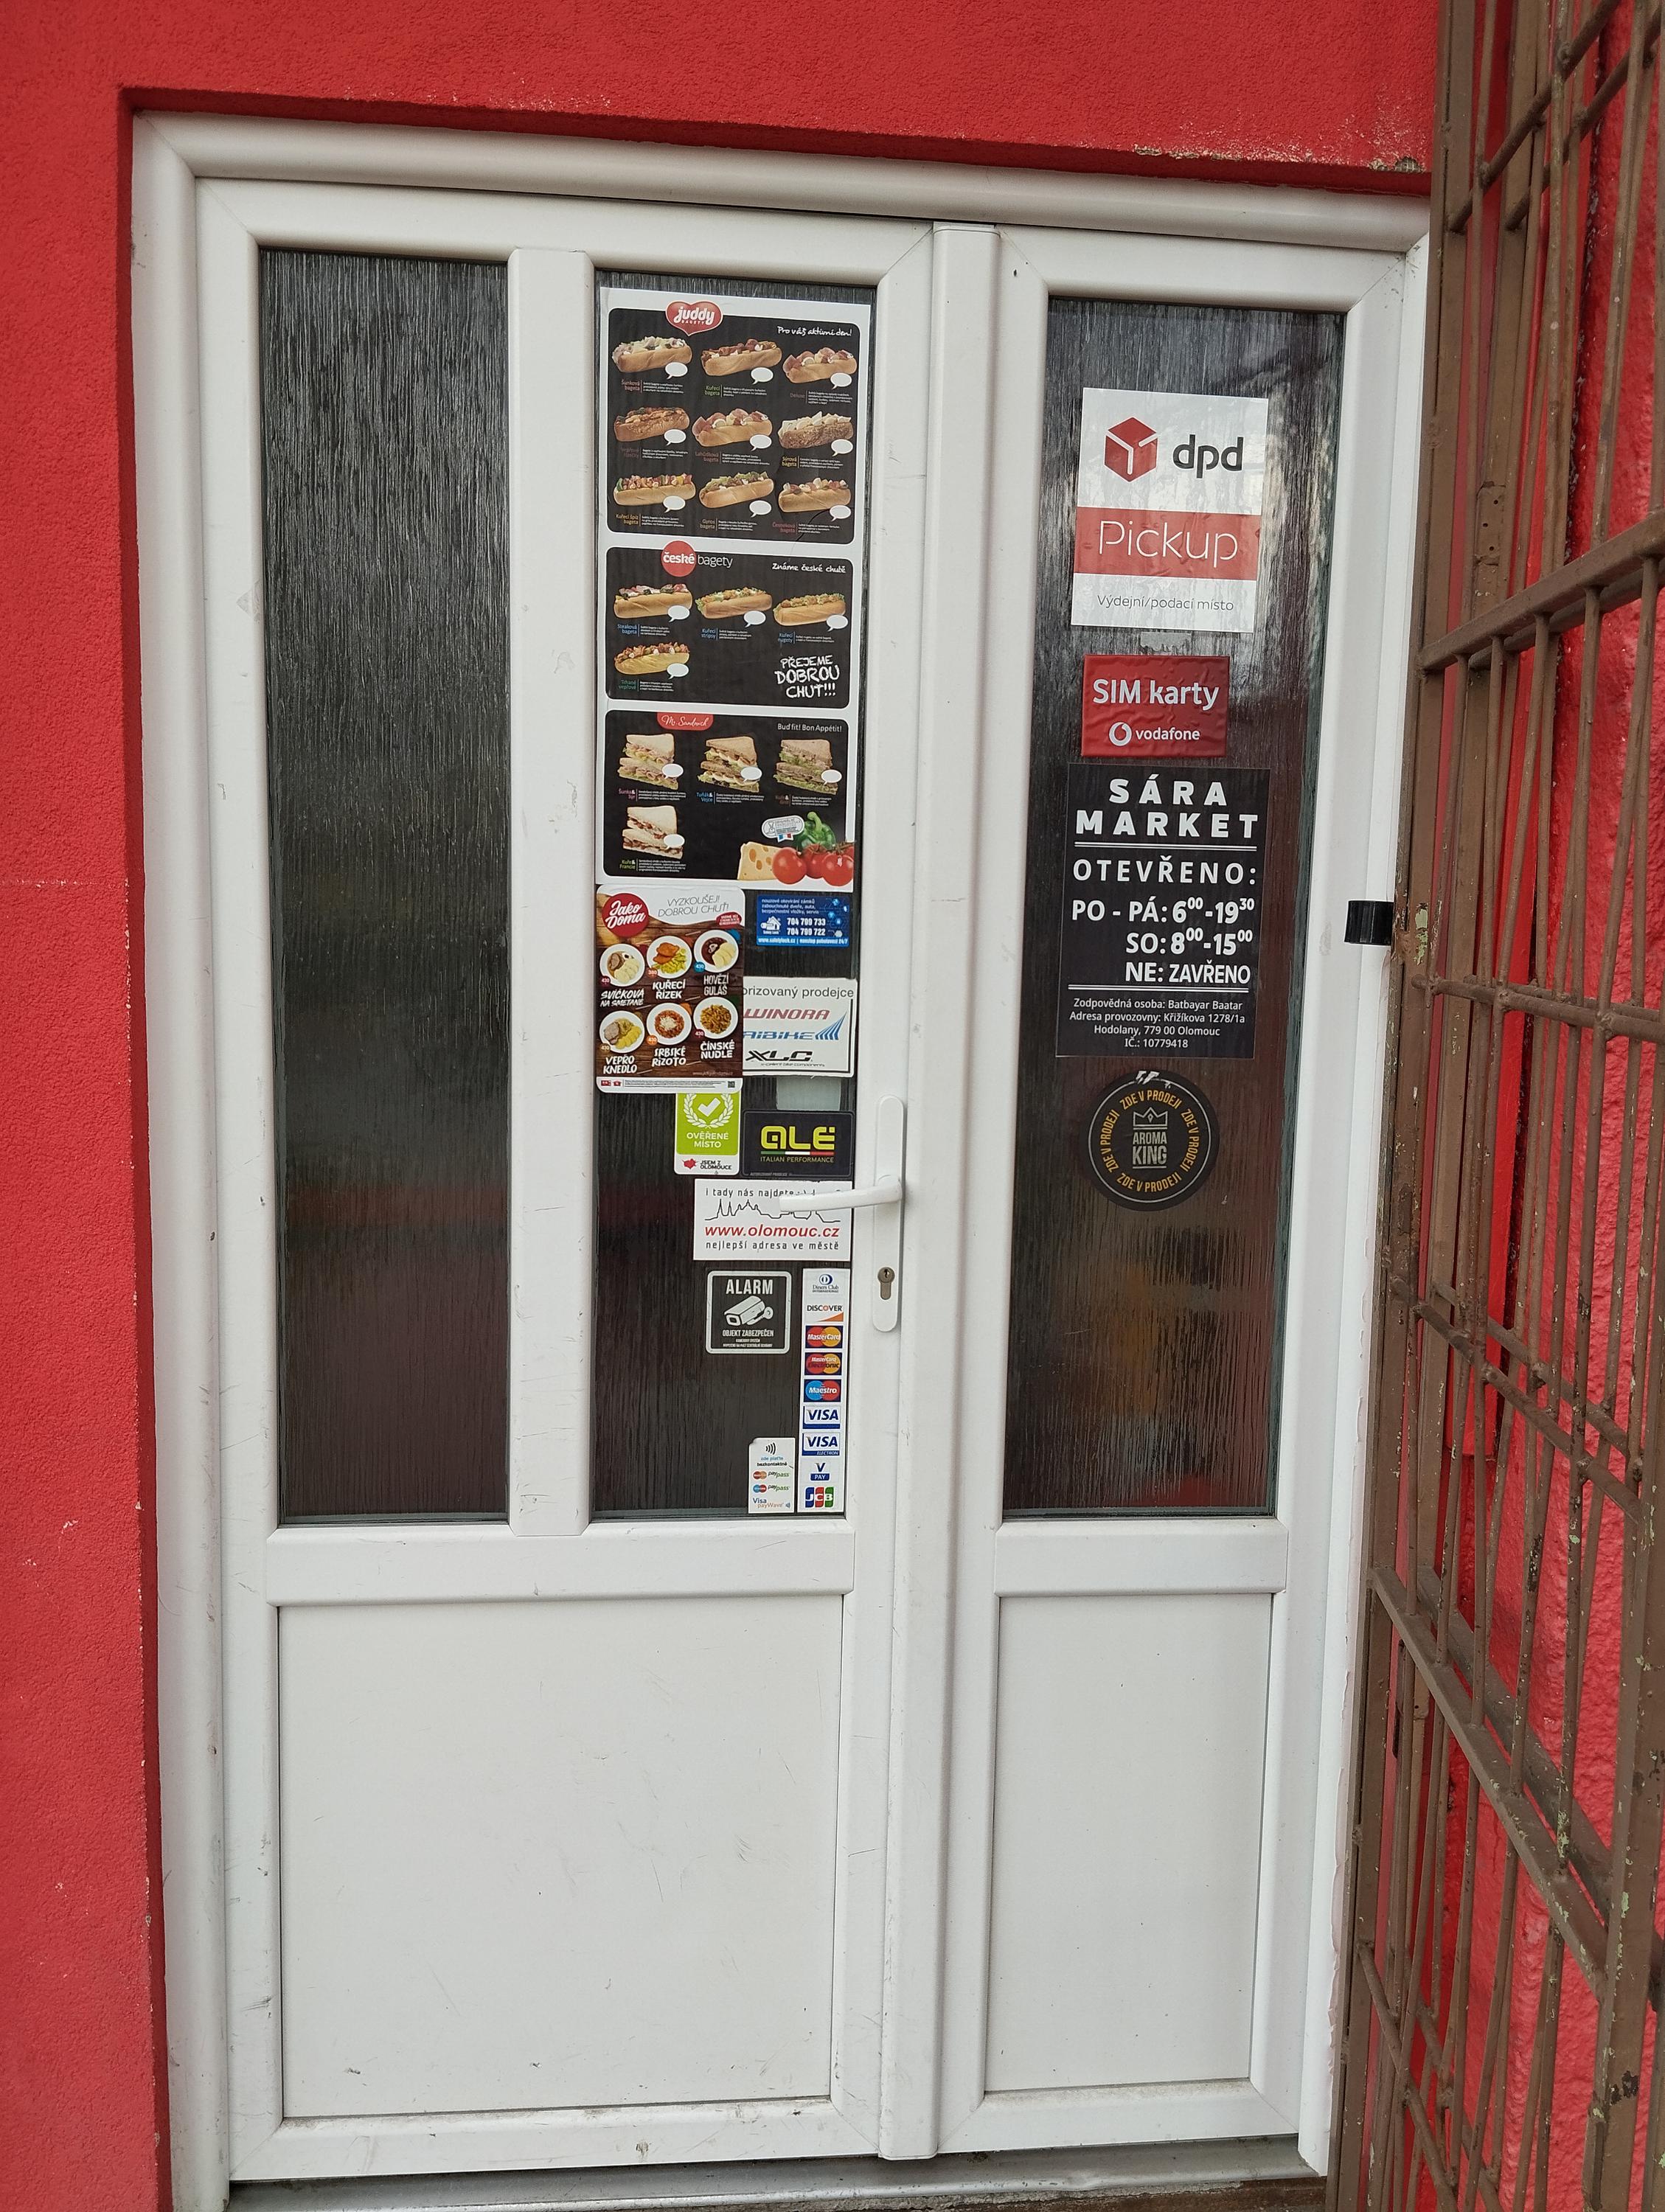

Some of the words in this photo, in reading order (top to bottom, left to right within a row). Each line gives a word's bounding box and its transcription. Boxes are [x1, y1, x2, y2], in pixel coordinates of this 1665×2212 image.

[674, 307, 715, 325] juddy
[777, 326, 790, 335] Pro
[1172, 434, 1244, 479] dpd
[1098, 520, 1238, 568] Pickup
[663, 552, 695, 564] české
[698, 555, 733, 568] bagety
[772, 563, 799, 571] Známe
[802, 564, 823, 572] české
[826, 565, 847, 573] chutě
[1097, 594, 1193, 611] Výdejní/podací
[1198, 599, 1234, 611] místo
[780, 655, 833, 669] PŘEJEME
[774, 664, 840, 684] DOBROU
[1093, 679, 1141, 704] SIM
[1149, 680, 1220, 712] karty
[1136, 727, 1200, 740] vodafone
[1109, 773, 1227, 806] SÁRA
[1076, 810, 1258, 838] MARKET
[1073, 855, 1256, 885] OTEVŘENO:
[667, 894, 720, 906] VYZKOUŠEJ!
[610, 900, 642, 916] Jako
[658, 906, 698, 917] DOBROU
[1072, 900, 1105, 921] PO
[605, 912, 646, 928] Doma
[787, 917, 799, 926] 704
[813, 918, 826, 926] 733
[787, 928, 799, 936] 704
[1125, 961, 1164, 982] NE:
[1169, 959, 1251, 984] ZAVŘENO
[653, 979, 686, 990] KUŘECÍ
[703, 973, 729, 985] HOVĚZÍ
[656, 989, 682, 1000] ŘÍZEK
[704, 984, 728, 995] GULÁŠ
[743, 986, 798, 998] orizovaný
[802, 987, 854, 999] prodejce
[1074, 998, 1131, 1009] Zodpovědná
[1134, 1000, 1165, 1009] osoba:
[1168, 1001, 1209, 1012] Batbayar
[1212, 1001, 1242, 1010] Baatar
[743, 1009, 830, 1020] WINORA
[1069, 1012, 1102, 1020] Adresa
[1105, 1014, 1161, 1023] provozovny:
[1164, 1013, 1205, 1023] Křižíkova
[1208, 1014, 1245, 1023] 1278/1a
[743, 1031, 814, 1040] AIBIKE
[1094, 1025, 1141, 1036] Hodolany,
[1144, 1026, 1161, 1034] 779
[1164, 1026, 1175, 1035] 00
[1178, 1026, 1220, 1036] Olomouc
[701, 1039, 735, 1051] ČÍNSKÉ
[1125, 1036, 1140, 1047] IČ.:
[1143, 1039, 1189, 1048] 10779418
[654, 1046, 686, 1057] SRBSKÉ
[701, 1050, 733, 1060] NUDLE
[745, 1050, 813, 1061] XLC
[605, 1054, 635, 1065] VEPŘO
[603, 1065, 637, 1074] KNEDLO
[1119, 1094, 1138, 1110] ZDE
[1138, 1091, 1144, 1102] V
[1147, 1090, 1182, 1109] PRODEJI
[1181, 1108, 1197, 1127] ZDE
[1100, 1110, 1120, 1145] PRODEJI
[686, 1131, 729, 1140] OVĚŘENÉ
[1133, 1132, 1167, 1144] AROMA
[694, 1140, 721, 1148] MÍSTO
[1133, 1146, 1167, 1165] KING
[1181, 1136, 1199, 1172] PRODEJI
[1103, 1155, 1119, 1172] ZDE
[1116, 1172, 1134, 1189] ZDE
[1136, 1180, 1143, 1192] V
[1145, 1172, 1182, 1192] PRODEJI
[713, 1188, 733, 1198] tady
[738, 1188, 754, 1197] nás
[705, 1224, 840, 1237] www.olomouc.cz
[706, 1240, 748, 1251] nejlepší
[752, 1241, 787, 1250] adresa
[809, 1241, 839, 1250] městě
[726, 1279, 773, 1294] ALARM
[807, 1410, 838, 1420] VISA
[806, 1436, 838, 1447] VISA
[816, 1463, 825, 1472] V
